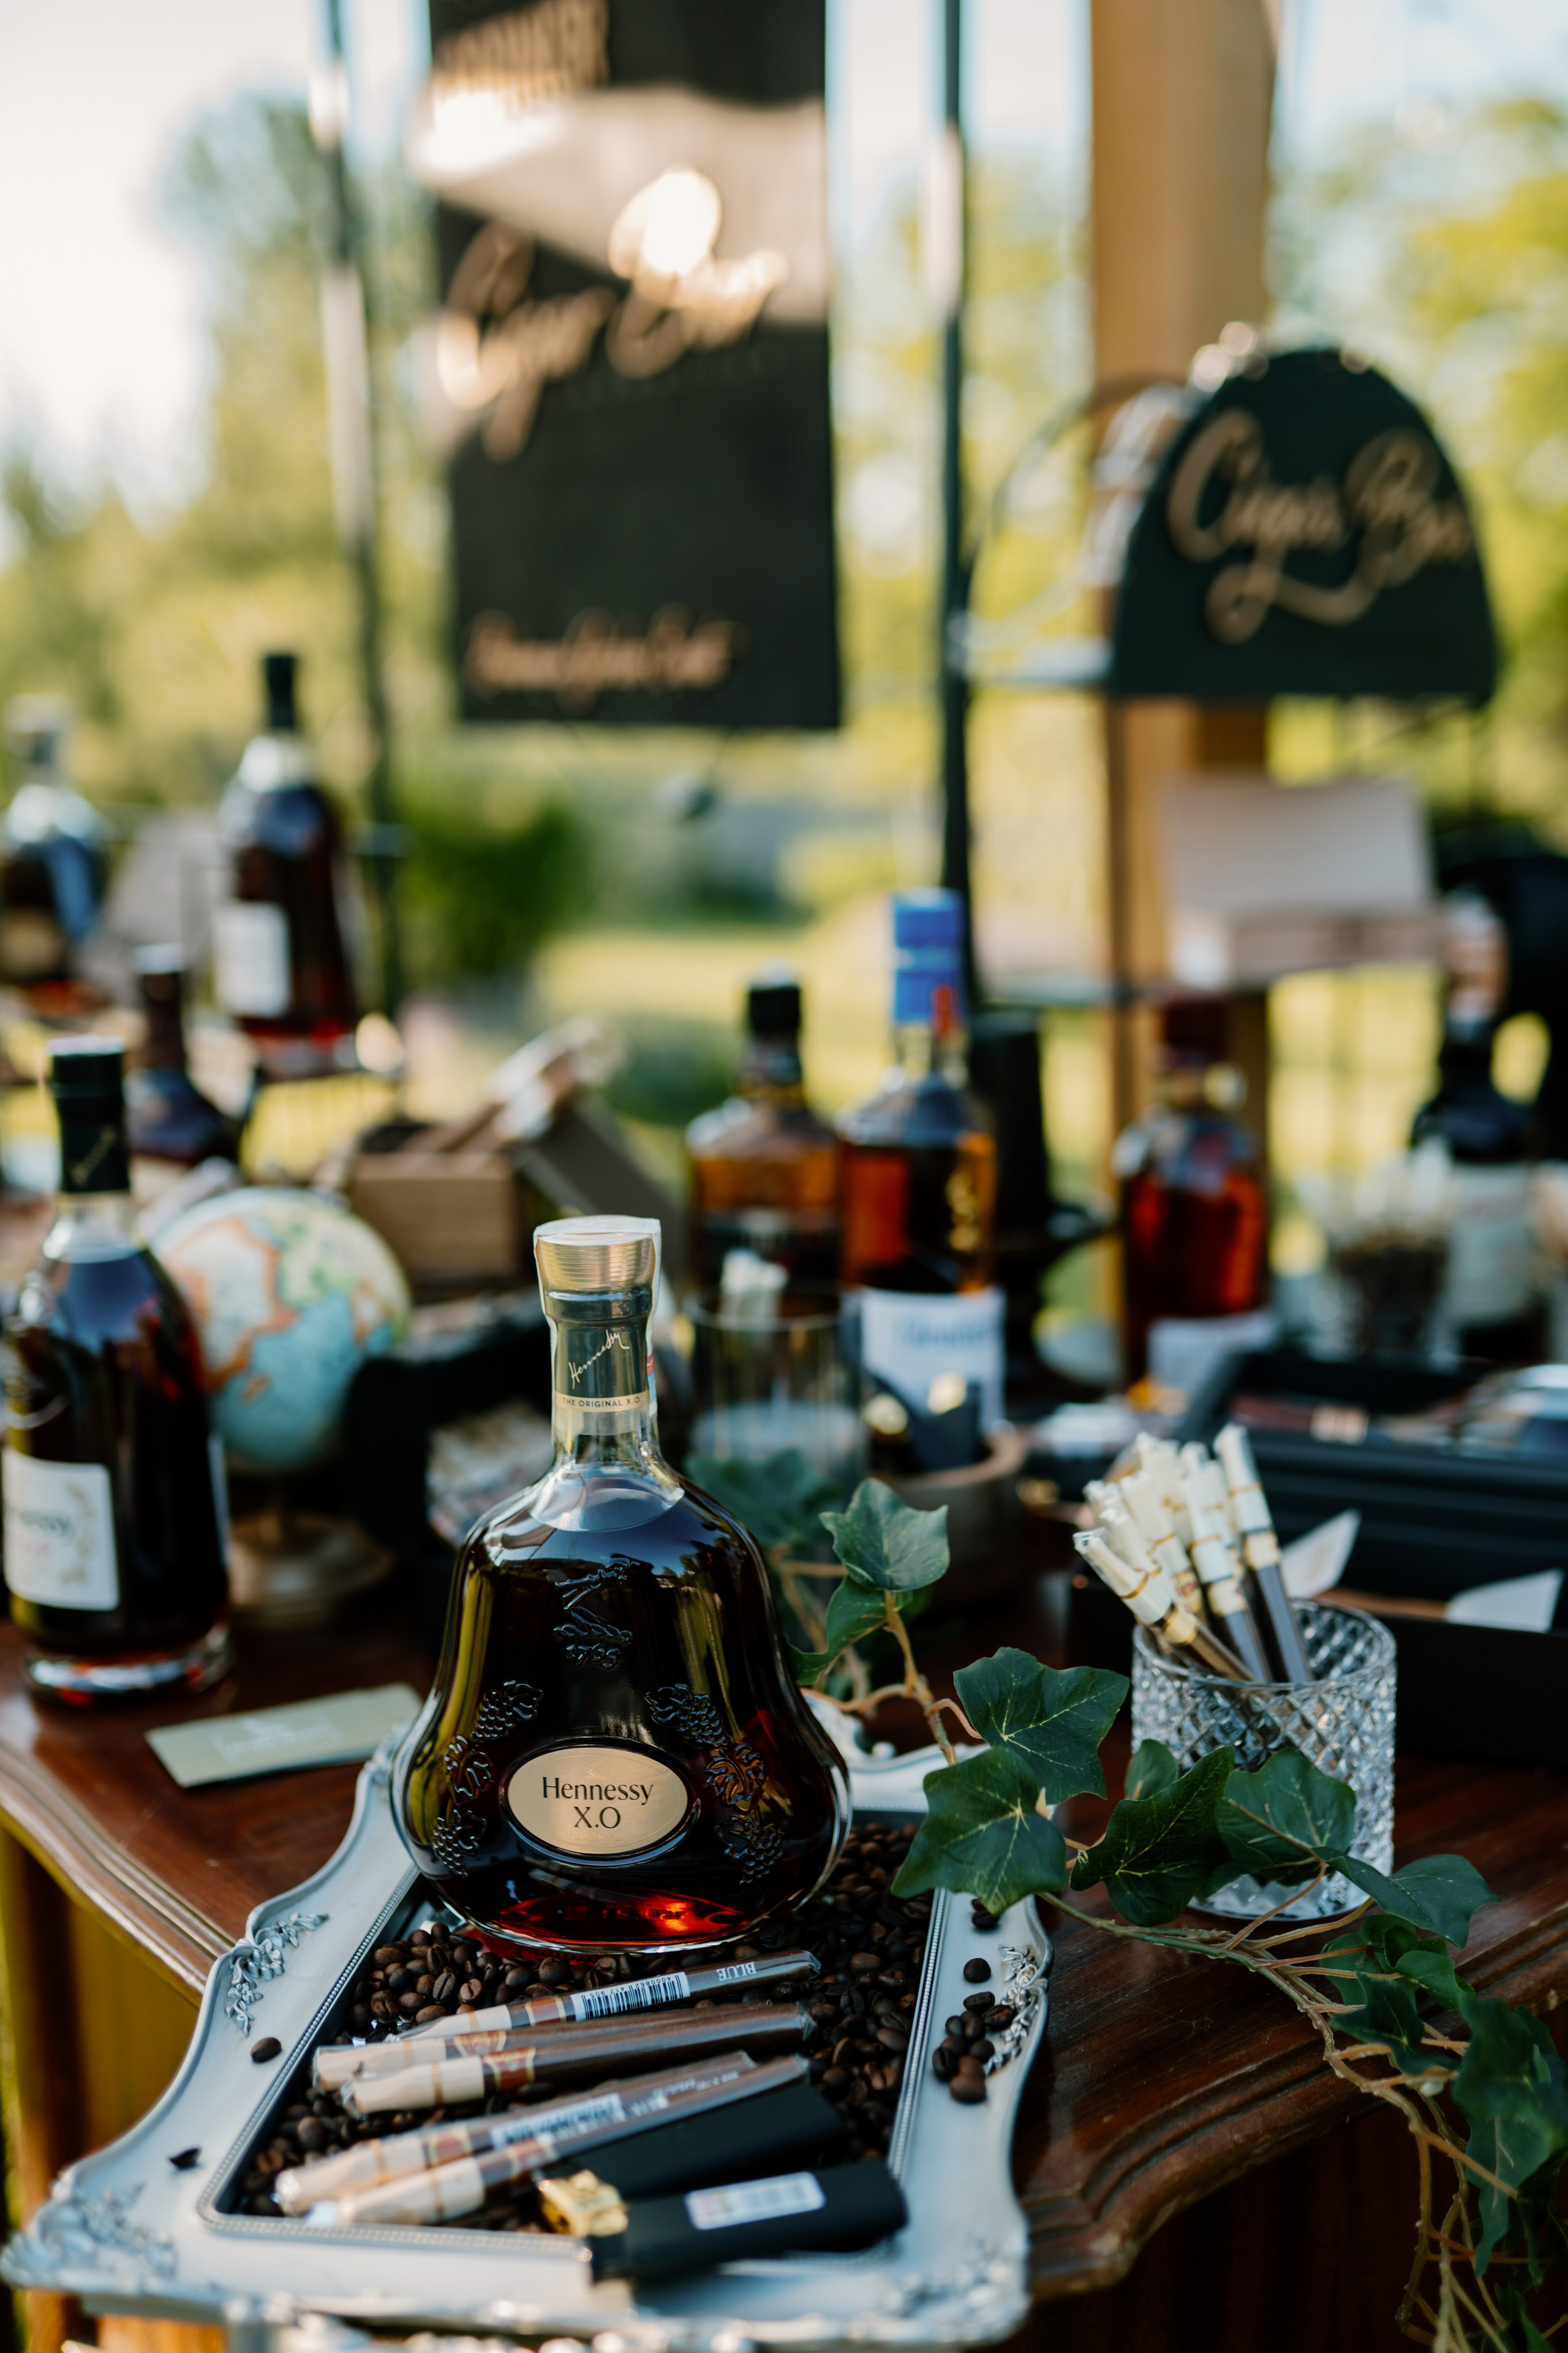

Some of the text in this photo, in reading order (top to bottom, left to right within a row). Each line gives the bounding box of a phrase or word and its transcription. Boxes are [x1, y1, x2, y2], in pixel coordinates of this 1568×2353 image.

[568, 1329, 630, 1389] Hennessy
[563, 1397, 576, 1406] THE
[566, 1643, 621, 1670] 1765
[543, 1777, 654, 1805] Hennessy
[574, 1807, 621, 1829] X.O
[635, 1976, 672, 1989] 4000862
[716, 1962, 758, 1981] BLUE
